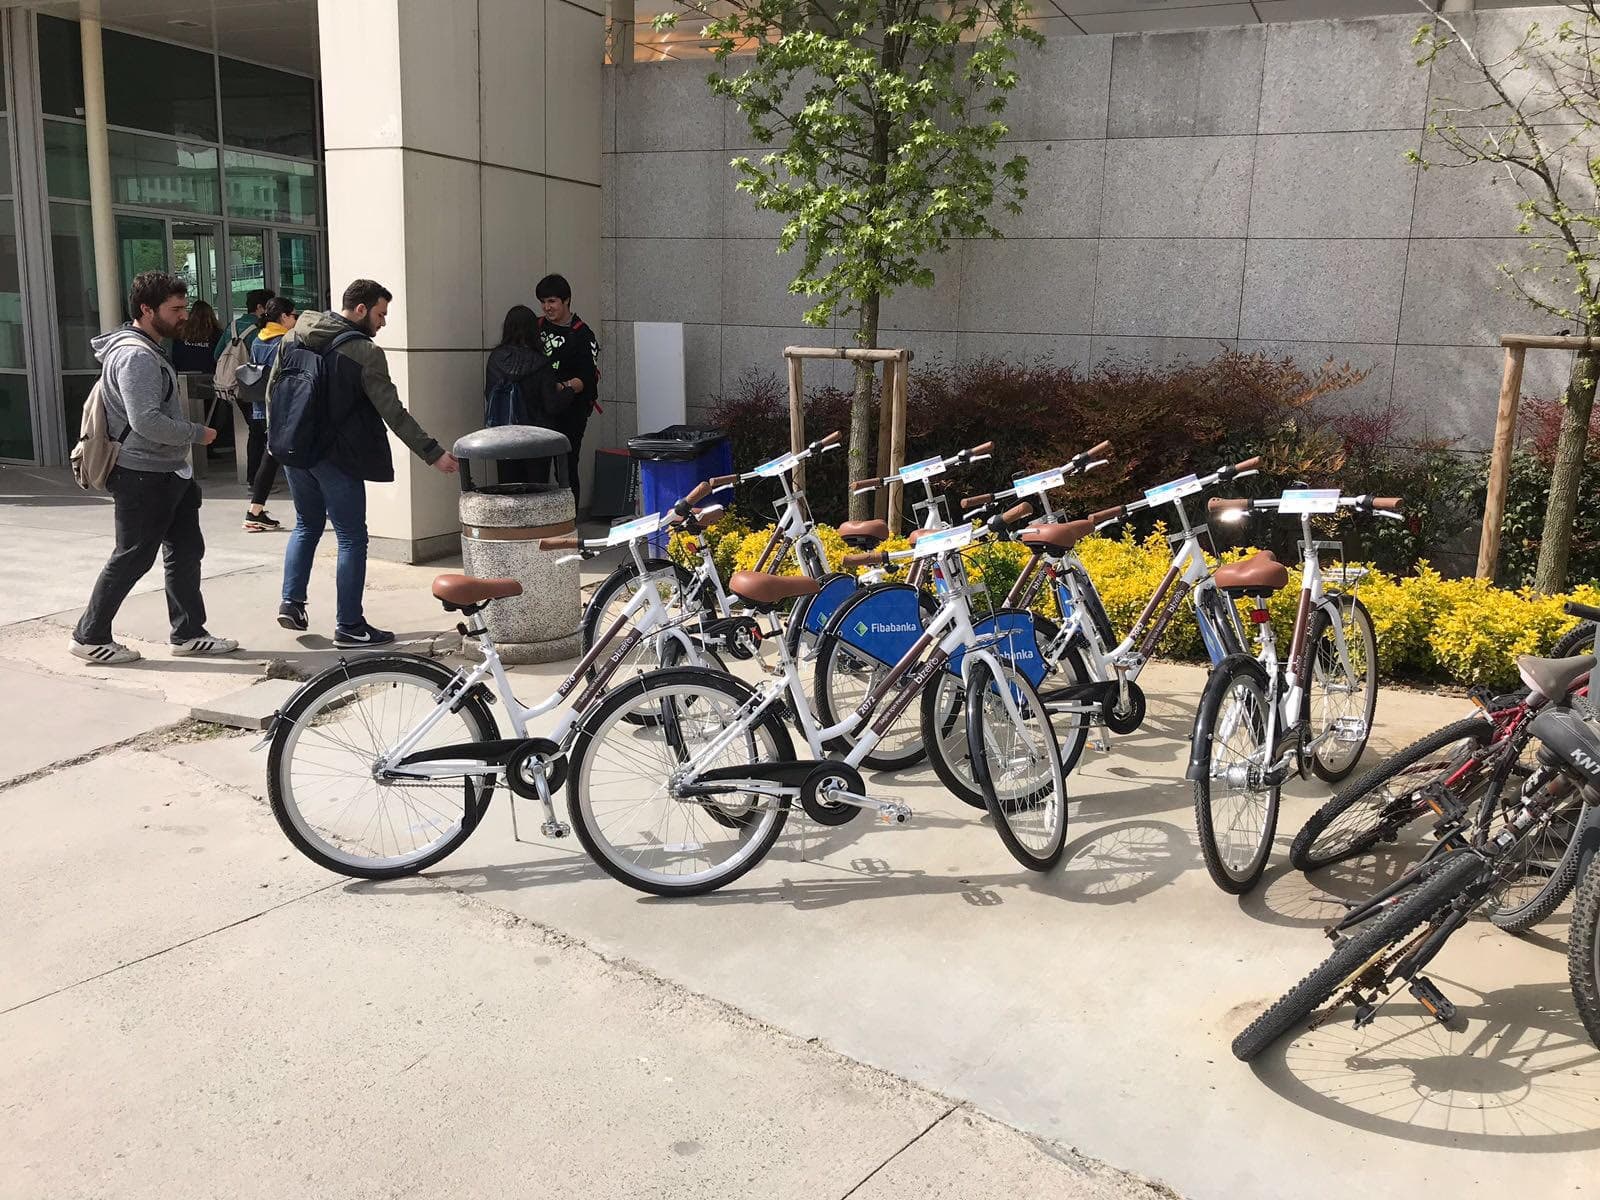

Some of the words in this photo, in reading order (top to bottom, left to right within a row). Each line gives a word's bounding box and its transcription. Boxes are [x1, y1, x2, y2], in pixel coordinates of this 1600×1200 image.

[871, 621, 917, 633] Fibabanka
[610, 636, 635, 663] bizero
[914, 656, 940, 685] bizero
[559, 674, 576, 693] 2070
[858, 696, 876, 715] 2072
